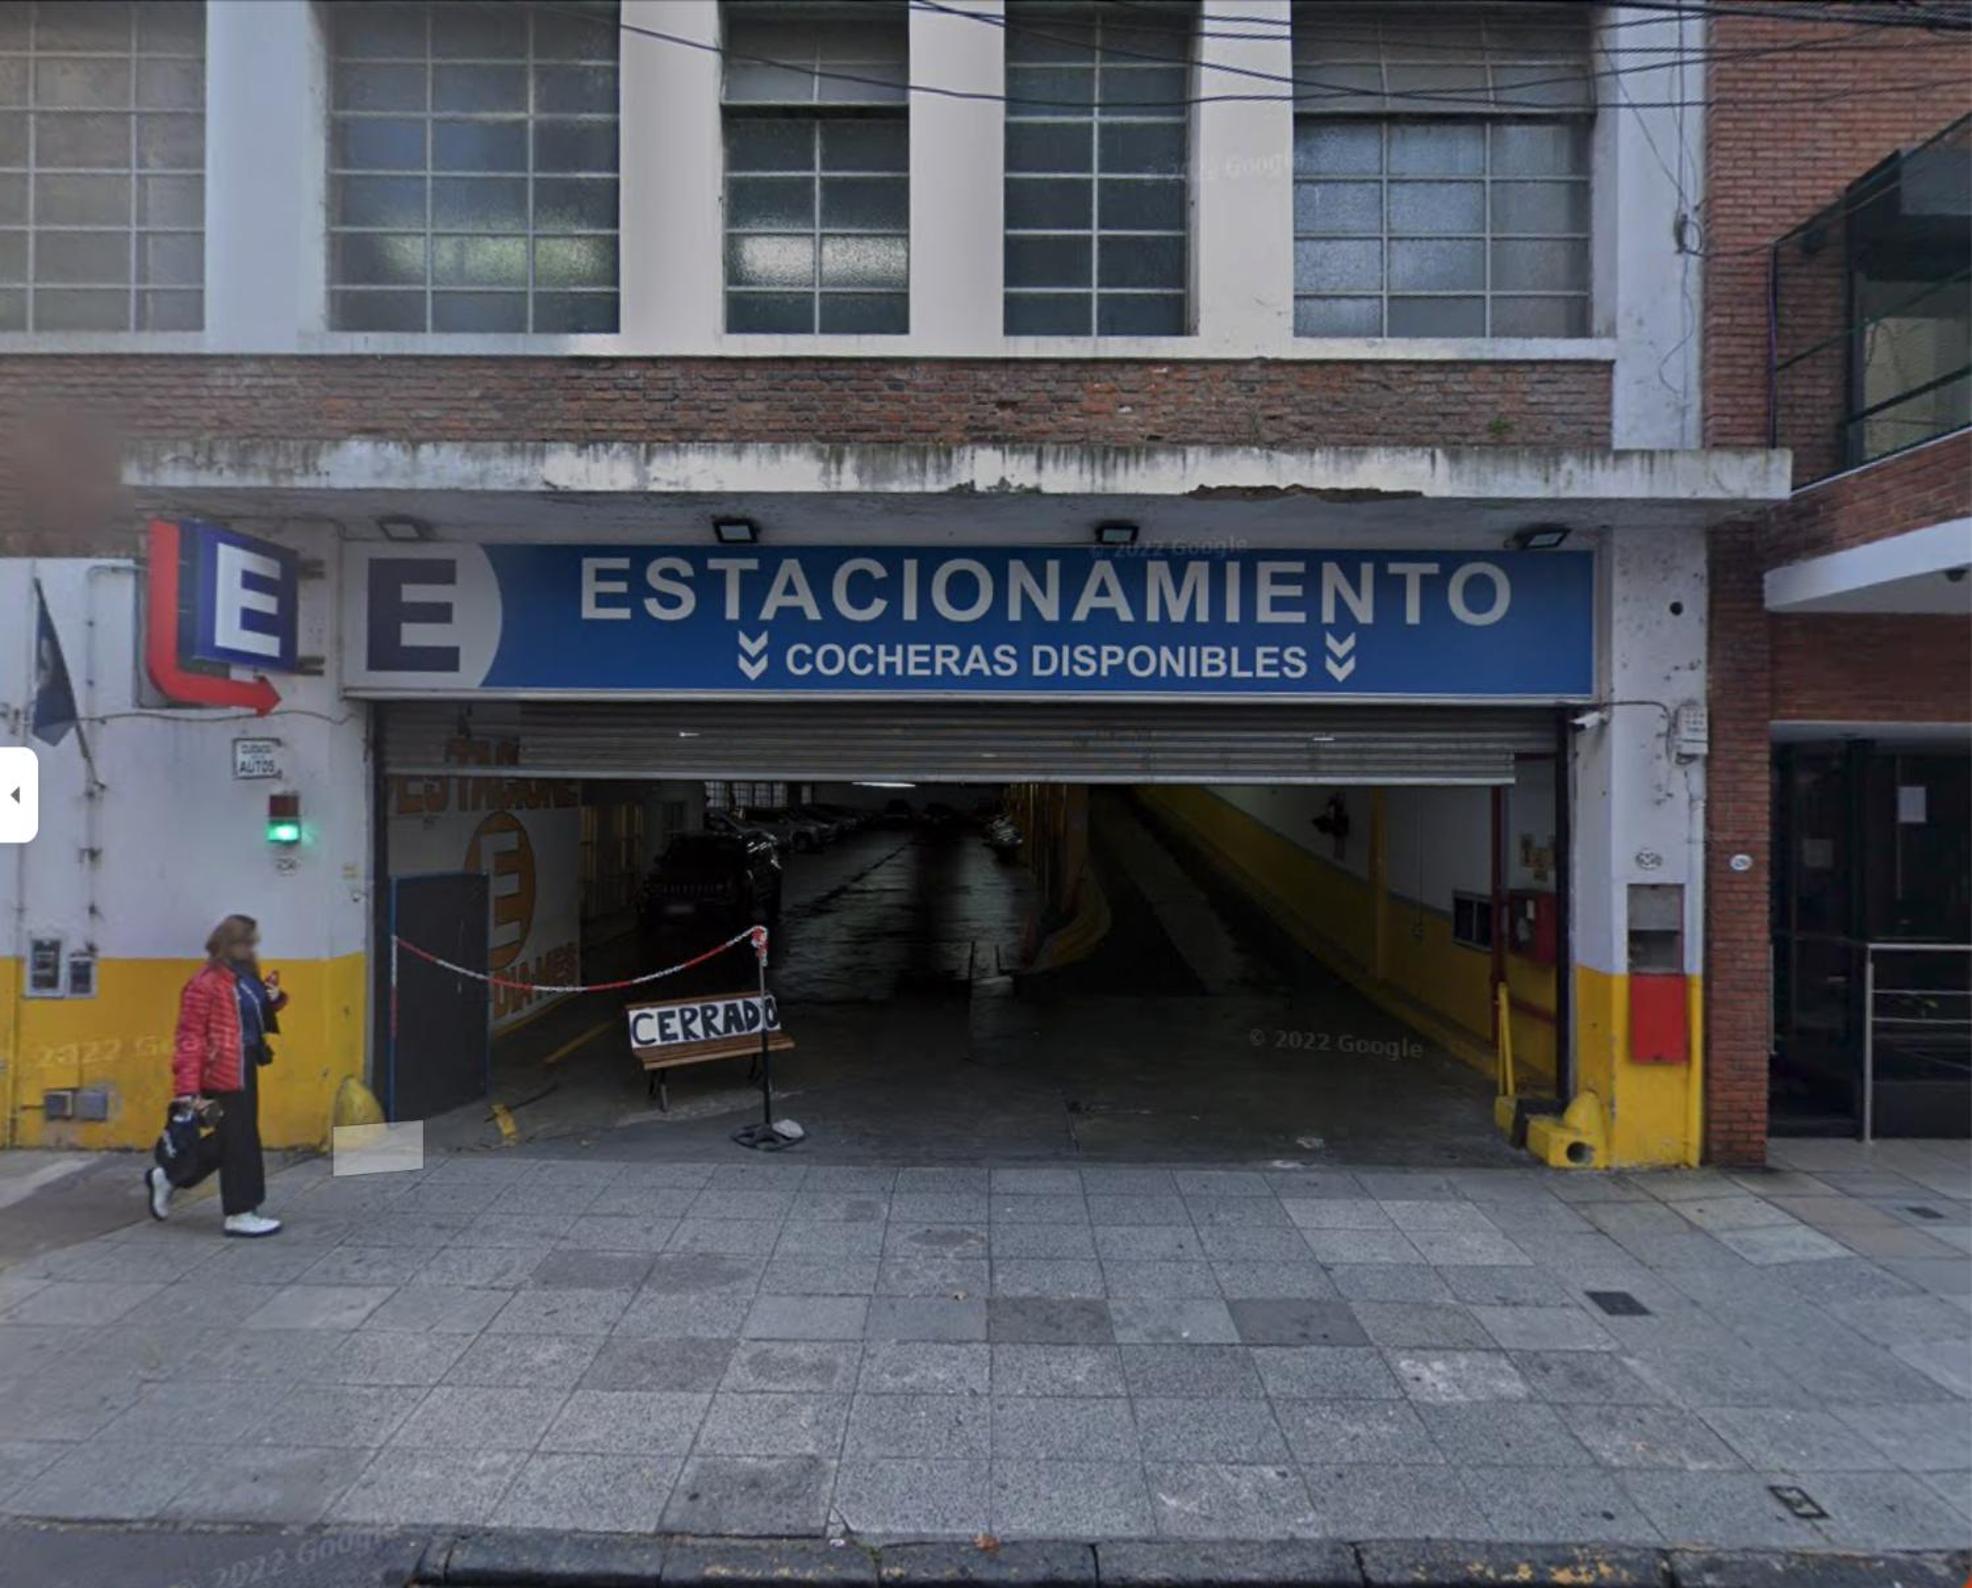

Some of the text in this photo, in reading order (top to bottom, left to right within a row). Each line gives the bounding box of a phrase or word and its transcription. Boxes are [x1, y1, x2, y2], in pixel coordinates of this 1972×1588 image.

[215, 542, 280, 658] E
[366, 558, 460, 672] E
[581, 556, 1512, 627] ESTACIONAMIENTO
[785, 643, 1308, 679] COCHERAS DISPONIBLES
[631, 997, 778, 1045] CERRADO
